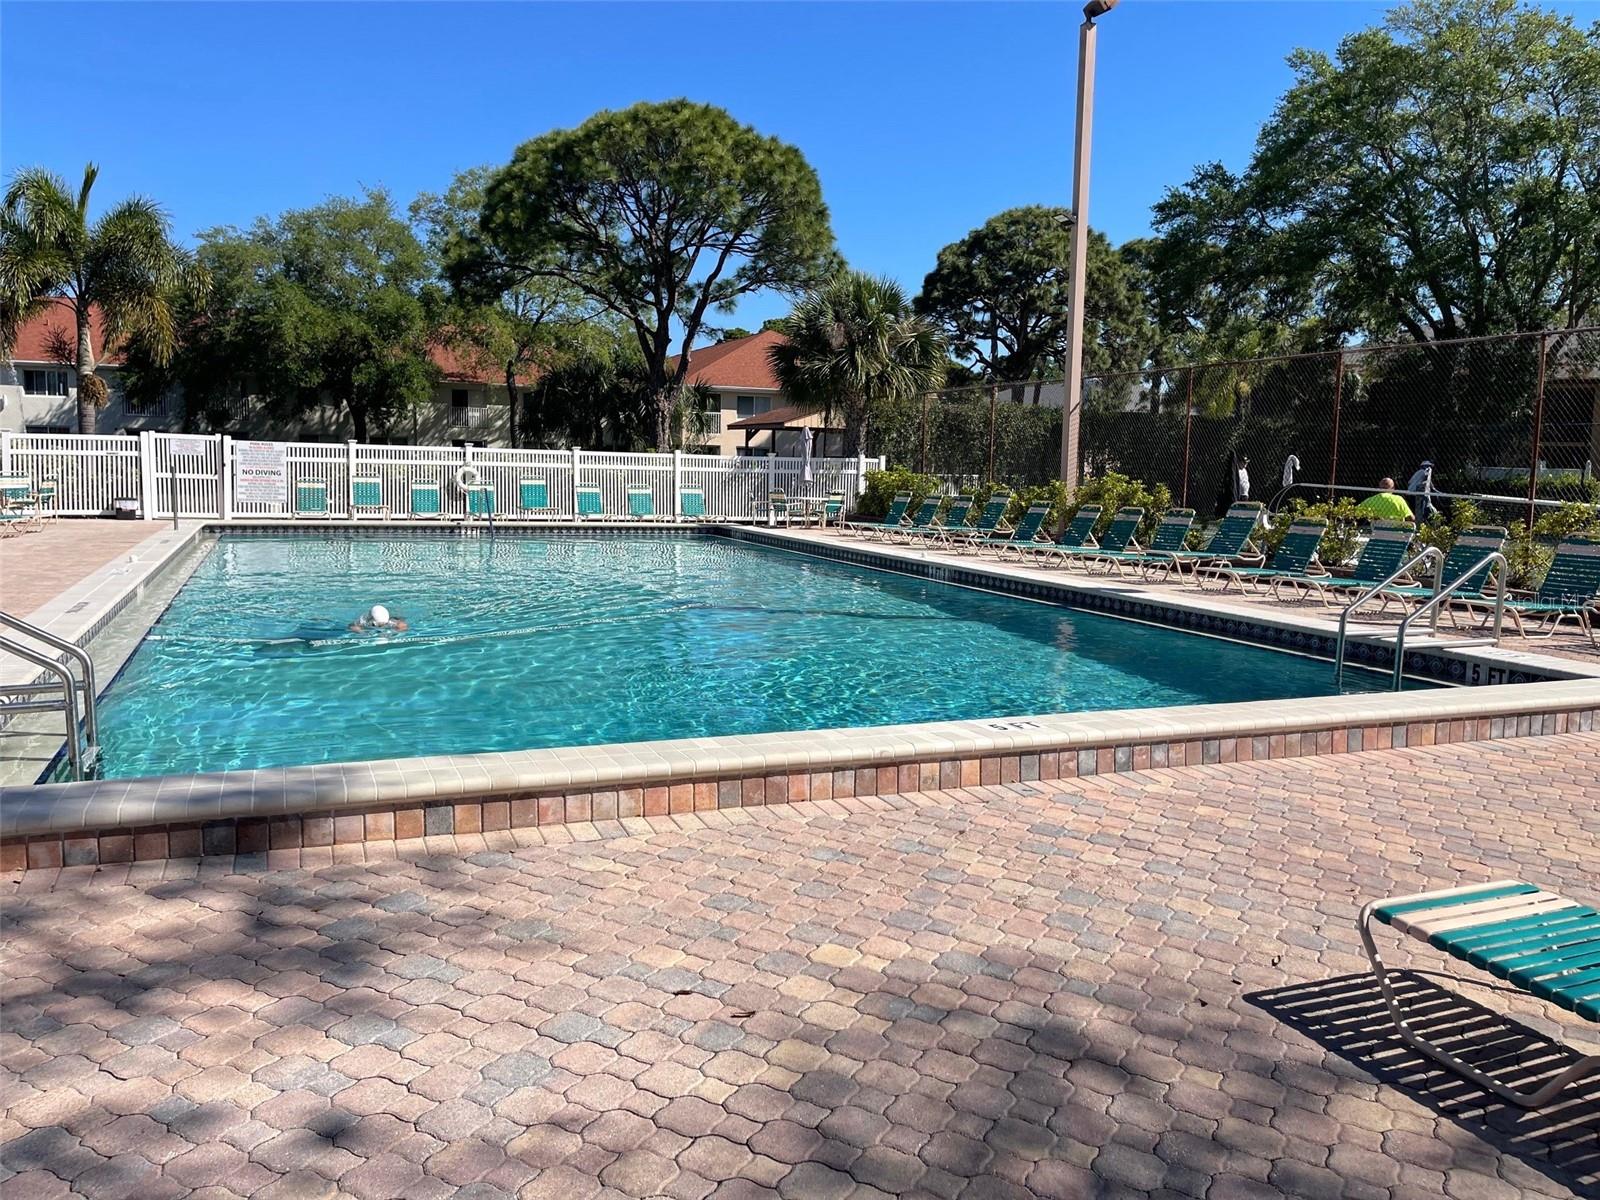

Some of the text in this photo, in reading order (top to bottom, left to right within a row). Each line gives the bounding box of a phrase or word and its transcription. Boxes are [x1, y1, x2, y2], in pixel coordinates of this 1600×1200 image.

[1472, 663, 1506, 685] 5 FT
[988, 721, 1040, 731] 5 FT
